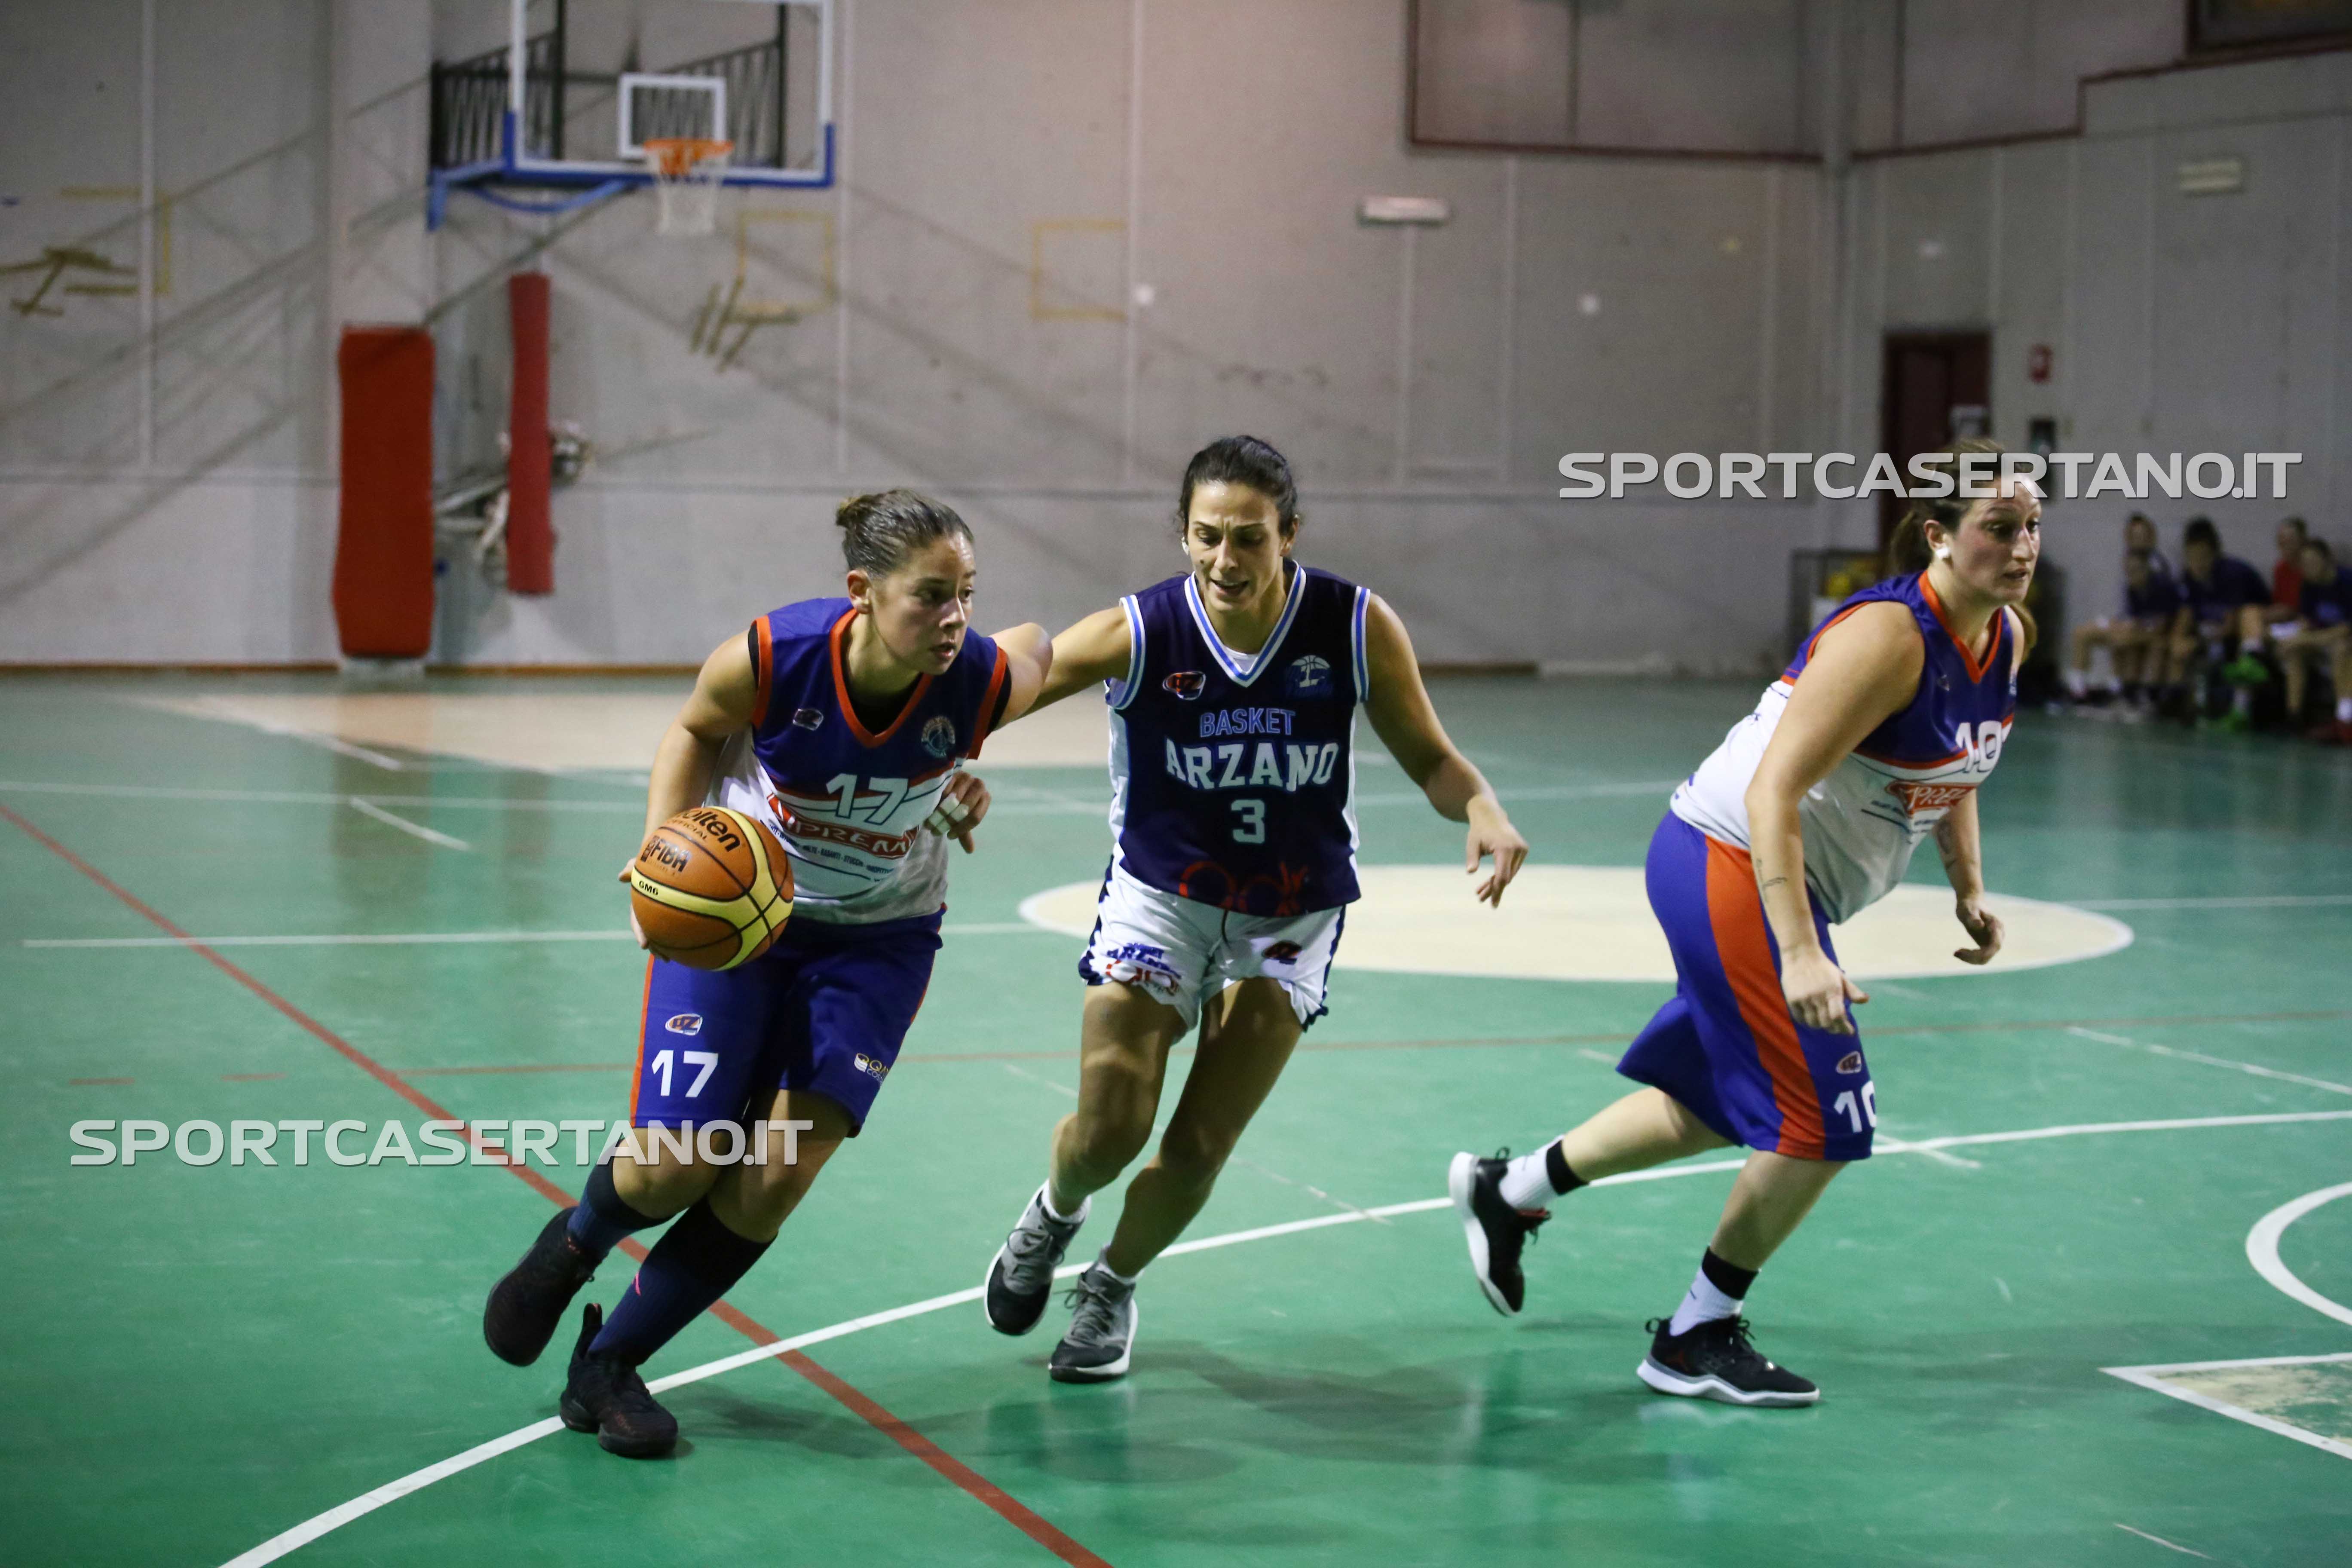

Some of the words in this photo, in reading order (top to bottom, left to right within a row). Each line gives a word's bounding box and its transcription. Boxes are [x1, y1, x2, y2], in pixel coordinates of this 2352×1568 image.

[1200, 707, 1295, 738] BASKET
[1166, 738, 1339, 792] ARZANO
[1955, 720, 2003, 773] 10
[826, 773, 909, 825] 17
[1231, 799, 1265, 843] 3
[682, 810, 740, 852] olten
[650, 838, 691, 873] FIBA
[652, 1050, 718, 1097] 17
